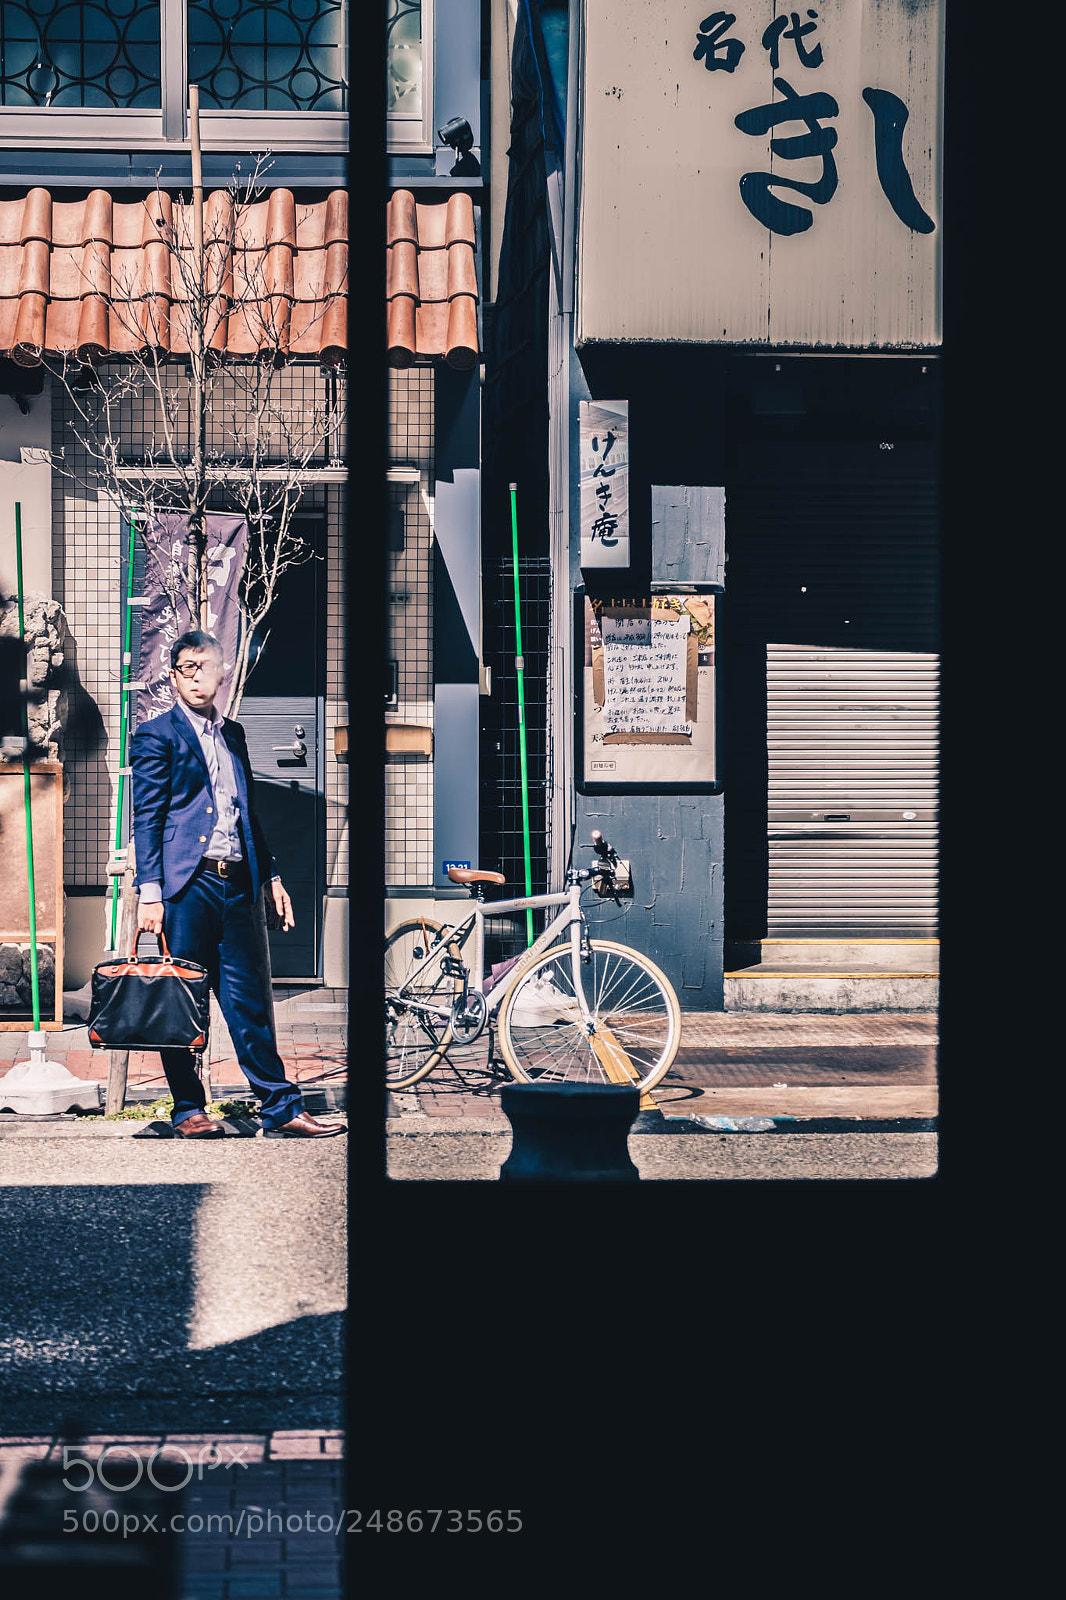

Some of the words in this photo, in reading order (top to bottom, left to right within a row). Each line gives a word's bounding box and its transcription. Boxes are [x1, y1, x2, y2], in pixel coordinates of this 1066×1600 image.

[693, 9, 824, 73] 名代
[591, 426, 619, 547] げんき庵
